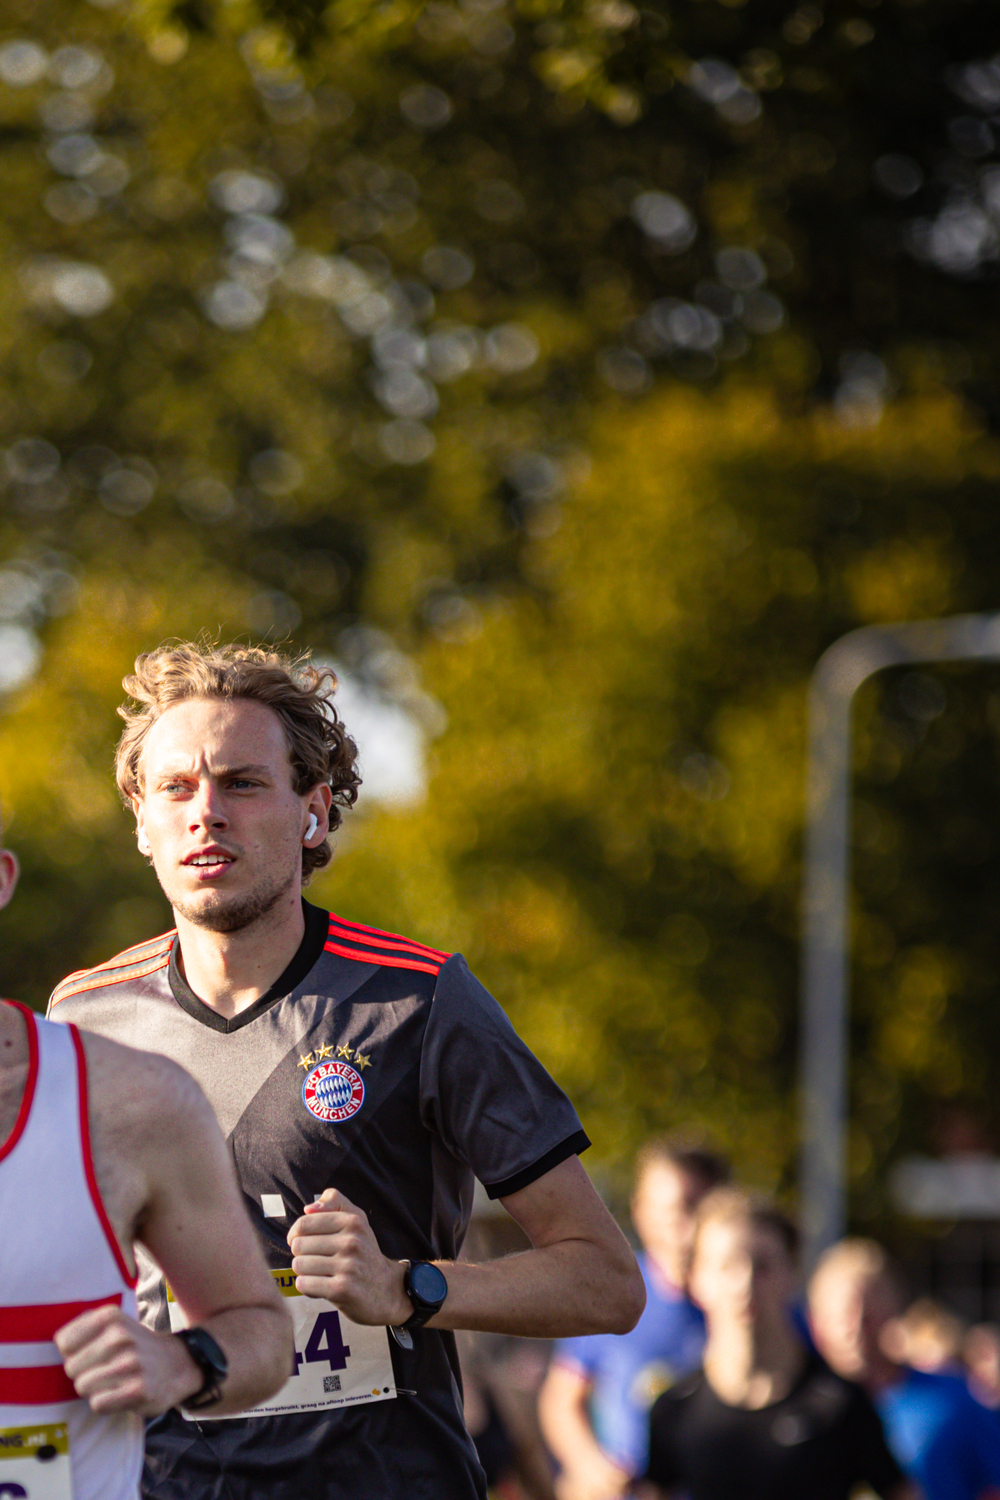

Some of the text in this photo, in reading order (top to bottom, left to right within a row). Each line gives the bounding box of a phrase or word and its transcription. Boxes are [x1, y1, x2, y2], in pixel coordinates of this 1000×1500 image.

[307, 1064, 362, 1091] FC BAYERN
[265, 1404, 300, 1413] hergebruikt,
[301, 1402, 317, 1410] graag
[326, 1398, 344, 1406] afloop
[345, 1393, 374, 1403] inleveren.
